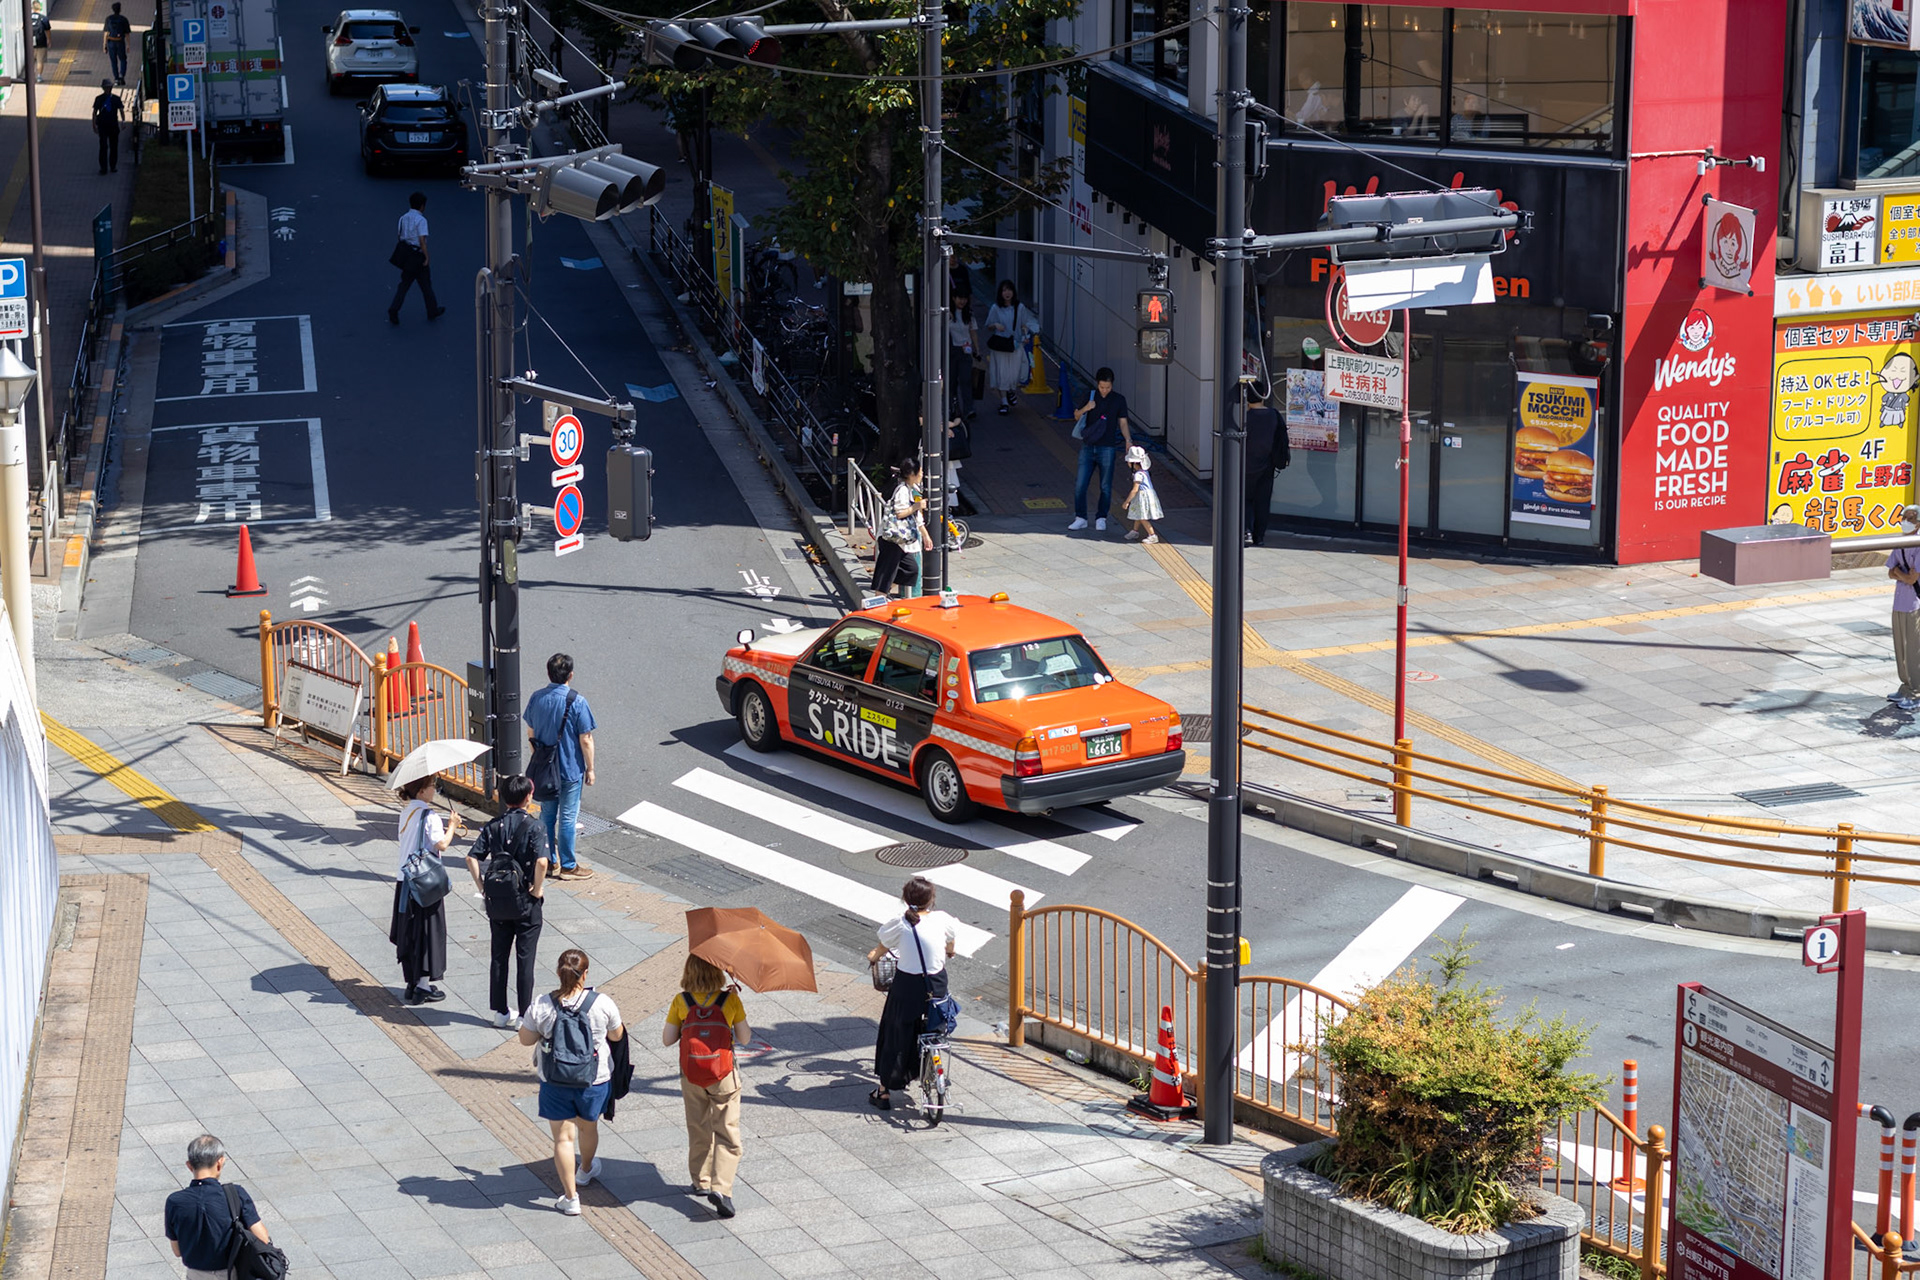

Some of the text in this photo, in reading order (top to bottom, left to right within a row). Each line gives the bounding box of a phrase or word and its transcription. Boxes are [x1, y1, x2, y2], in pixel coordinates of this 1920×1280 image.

[1830, 198, 1872, 213] すし酒場
[1822, 232, 1843, 242] SUSHI
[1890, 227, 1920, 240] 全9部
[1830, 241, 1866, 264] 富士
[1785, 320, 1915, 348] 個室セット専門店
[1328, 355, 1400, 378] 上野駅前クリニック
[1654, 347, 1737, 392] Wendy's
[1341, 371, 1388, 395] 性病科
[1781, 375, 1809, 393] 持込
[1814, 374, 1833, 389] OK
[1528, 392, 1585, 407] TSUKIMI
[1783, 394, 1867, 411] フード・ドリンク
[1527, 403, 1584, 418] MOCCHI
[1658, 401, 1730, 422] QUALITY
[1785, 410, 1861, 430] (アルコール可)
[559, 429, 576, 453] 30
[1657, 420, 1729, 448] FOOD
[1656, 445, 1728, 473] MADE
[1860, 439, 1885, 459] 4F
[194, 426, 262, 524] 貨物車専用
[1778, 449, 1850, 494] 麻雀
[1856, 462, 1913, 489] 上野店
[1655, 470, 1728, 498] FRESH
[1655, 495, 1727, 511] IS OUR RECIPE
[808, 673, 845, 692] MITSUYA TAXI
[808, 689, 859, 715] タクシーアプリ
[886, 698, 904, 711] 0123
[866, 710, 891, 725] エスライド
[808, 702, 899, 768] S.RIDE
[1094, 740, 1121, 755] 66-16
